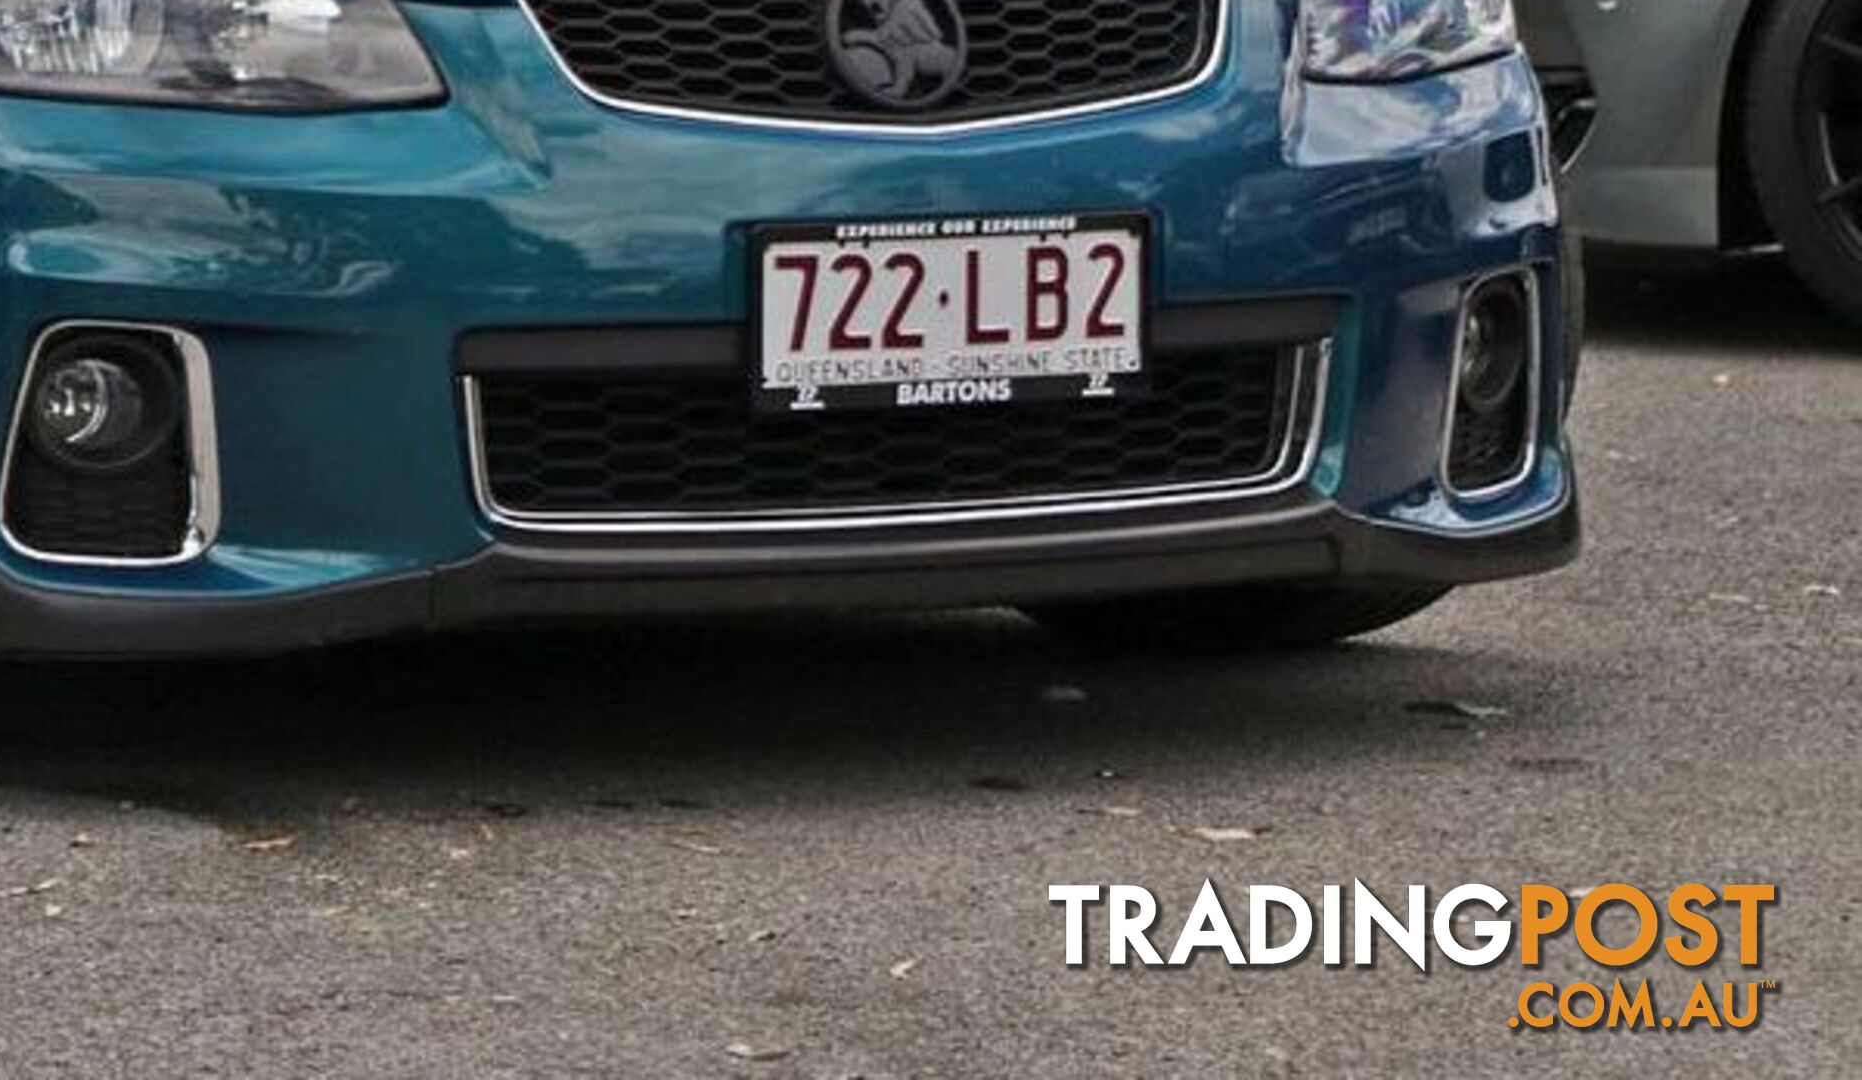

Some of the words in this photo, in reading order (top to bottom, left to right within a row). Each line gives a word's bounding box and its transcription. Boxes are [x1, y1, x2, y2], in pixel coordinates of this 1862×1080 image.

[836, 222, 936, 239] EXPERIENCE
[941, 220, 975, 234] OUR
[982, 216, 1077, 233] EXPERIENCE
[776, 358, 922, 383] QUEENSLAND
[947, 352, 1050, 377] SUNSHINE
[1067, 347, 1125, 371] STATE
[897, 379, 1012, 405] BARTONS
